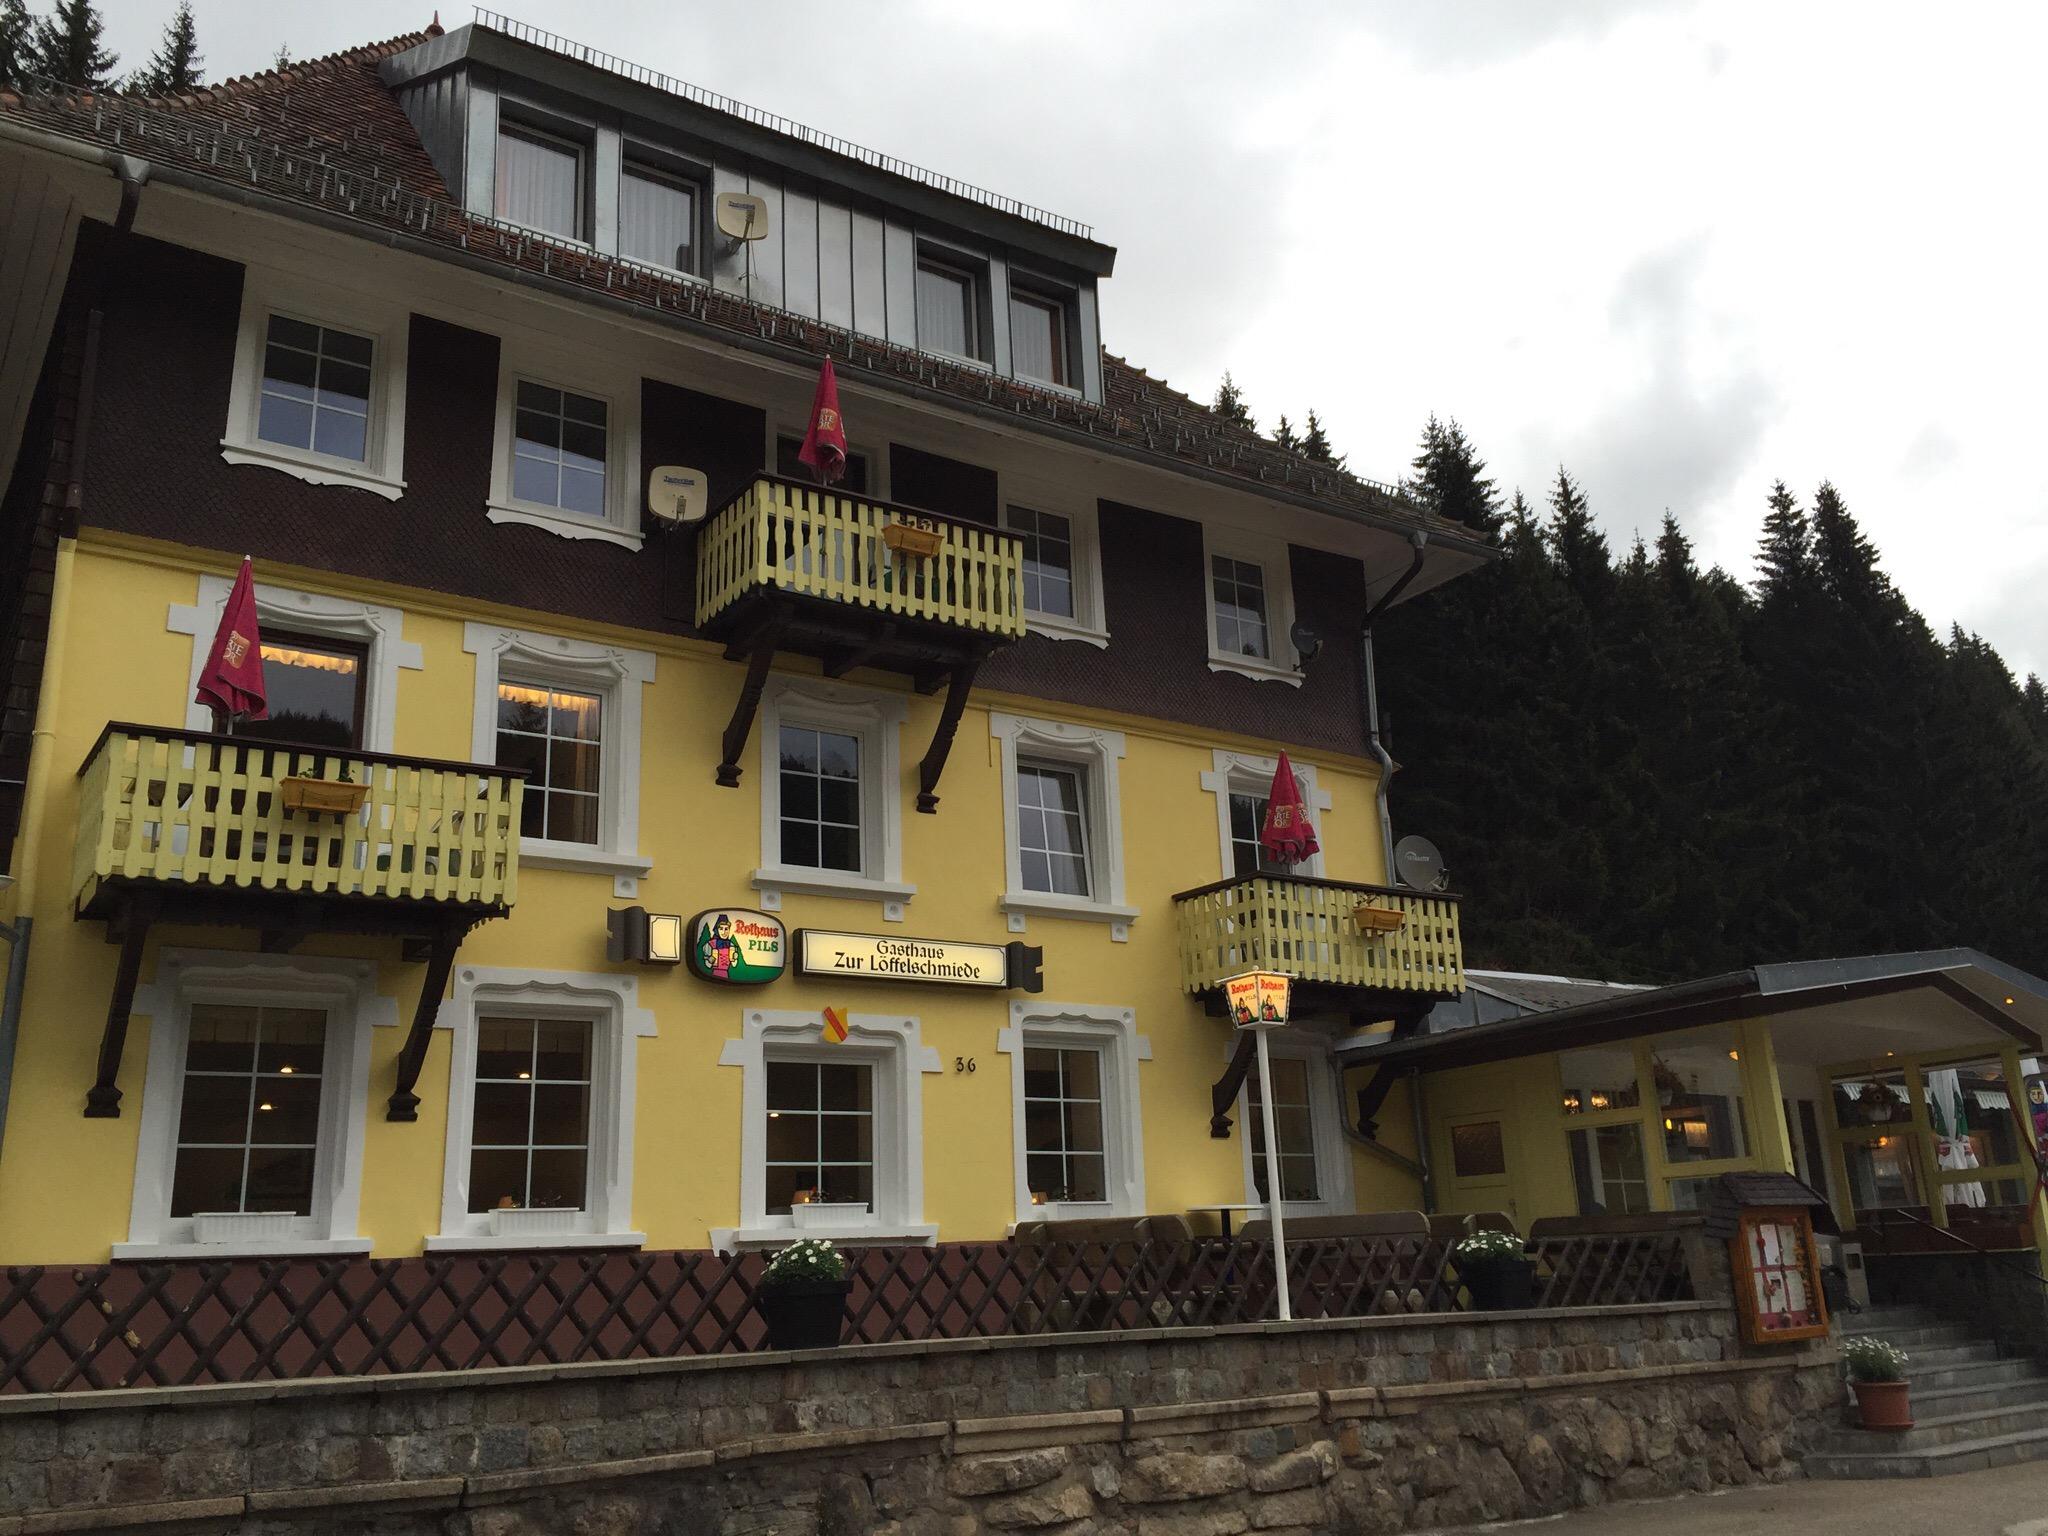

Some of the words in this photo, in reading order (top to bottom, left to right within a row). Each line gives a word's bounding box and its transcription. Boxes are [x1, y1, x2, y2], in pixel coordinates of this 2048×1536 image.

[734, 919, 779, 938] Rothaus
[748, 939, 779, 952] PILS
[876, 940, 945, 959] Gasthaus
[834, 951, 864, 970] Zur
[870, 954, 980, 979] Löffelschmiede
[955, 1056, 976, 1073] 36
